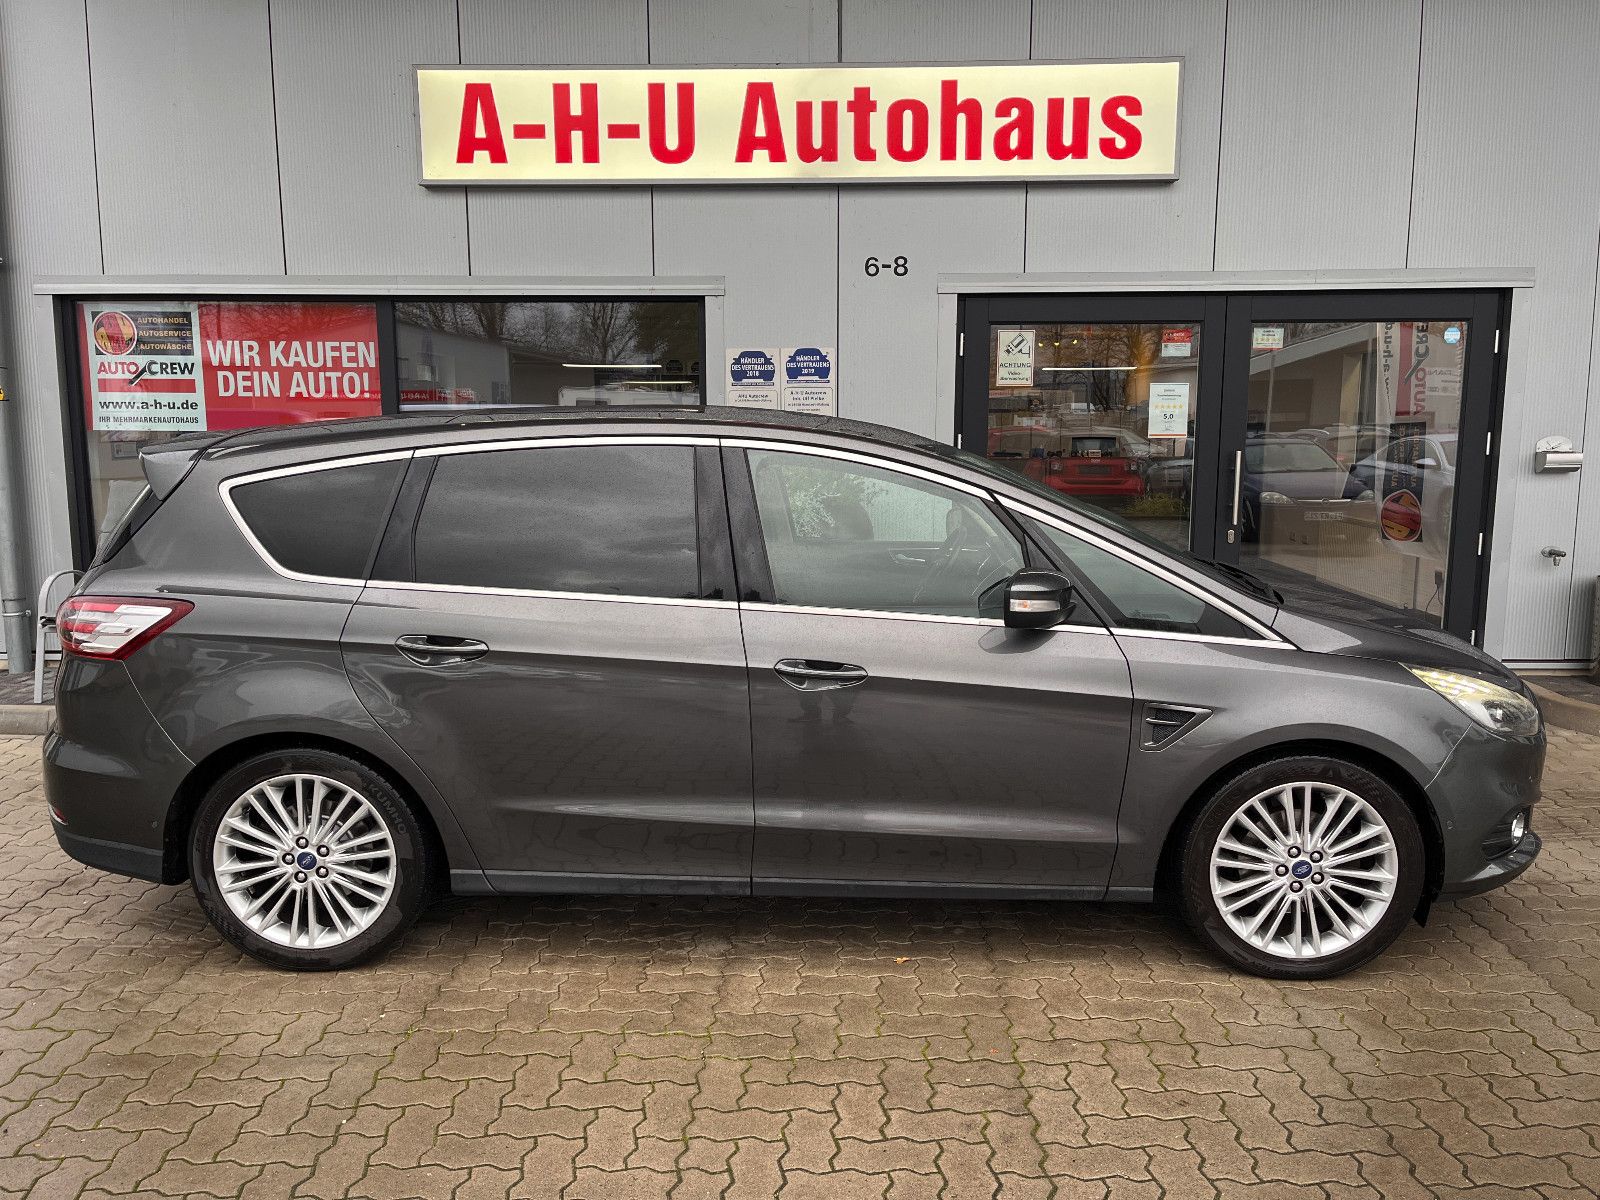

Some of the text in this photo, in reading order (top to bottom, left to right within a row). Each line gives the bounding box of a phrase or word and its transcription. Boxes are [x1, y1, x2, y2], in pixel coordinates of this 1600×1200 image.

[456, 79, 1143, 165] A-H-U Autohaus
[863, 256, 910, 278] 6-8
[138, 329, 192, 337] AUTOSERVICE
[140, 342, 193, 350] AUTOWÄSCHE
[206, 340, 376, 368] WIR KAUFEN
[97, 360, 195, 376] AUTO CREW
[217, 371, 371, 398] DEIN AUTO!
[99, 399, 199, 410] www.a-h-u.de
[113, 416, 199, 424] MEHRMARKENAUTOHAUS
